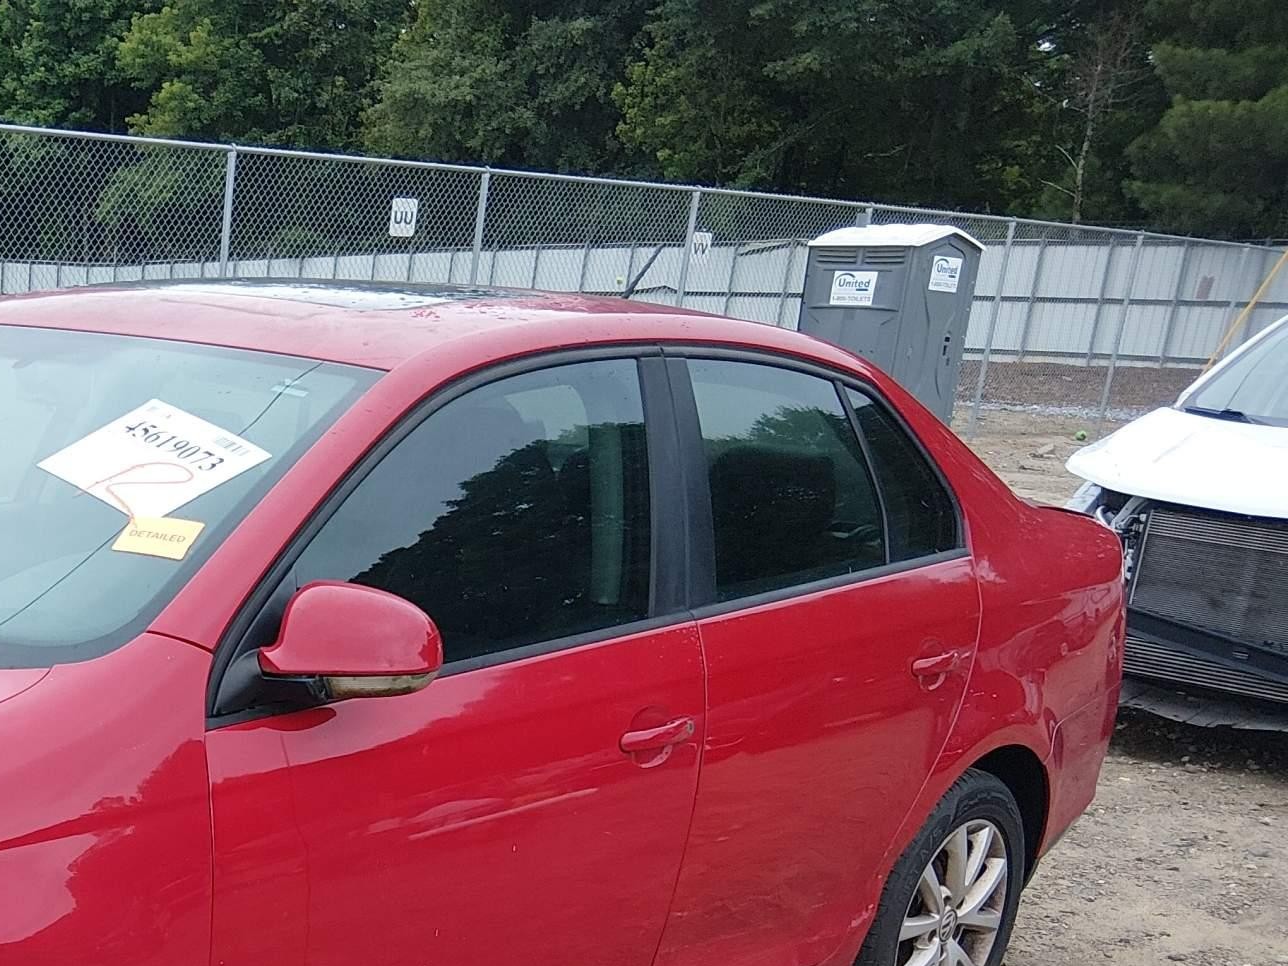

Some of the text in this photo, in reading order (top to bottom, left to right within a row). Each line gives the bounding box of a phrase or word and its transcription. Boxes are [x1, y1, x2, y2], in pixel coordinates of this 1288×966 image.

[394, 210, 413, 225] UU
[838, 277, 871, 288] United
[124, 420, 225, 471] 45619073
[128, 528, 187, 545] DETAILED
